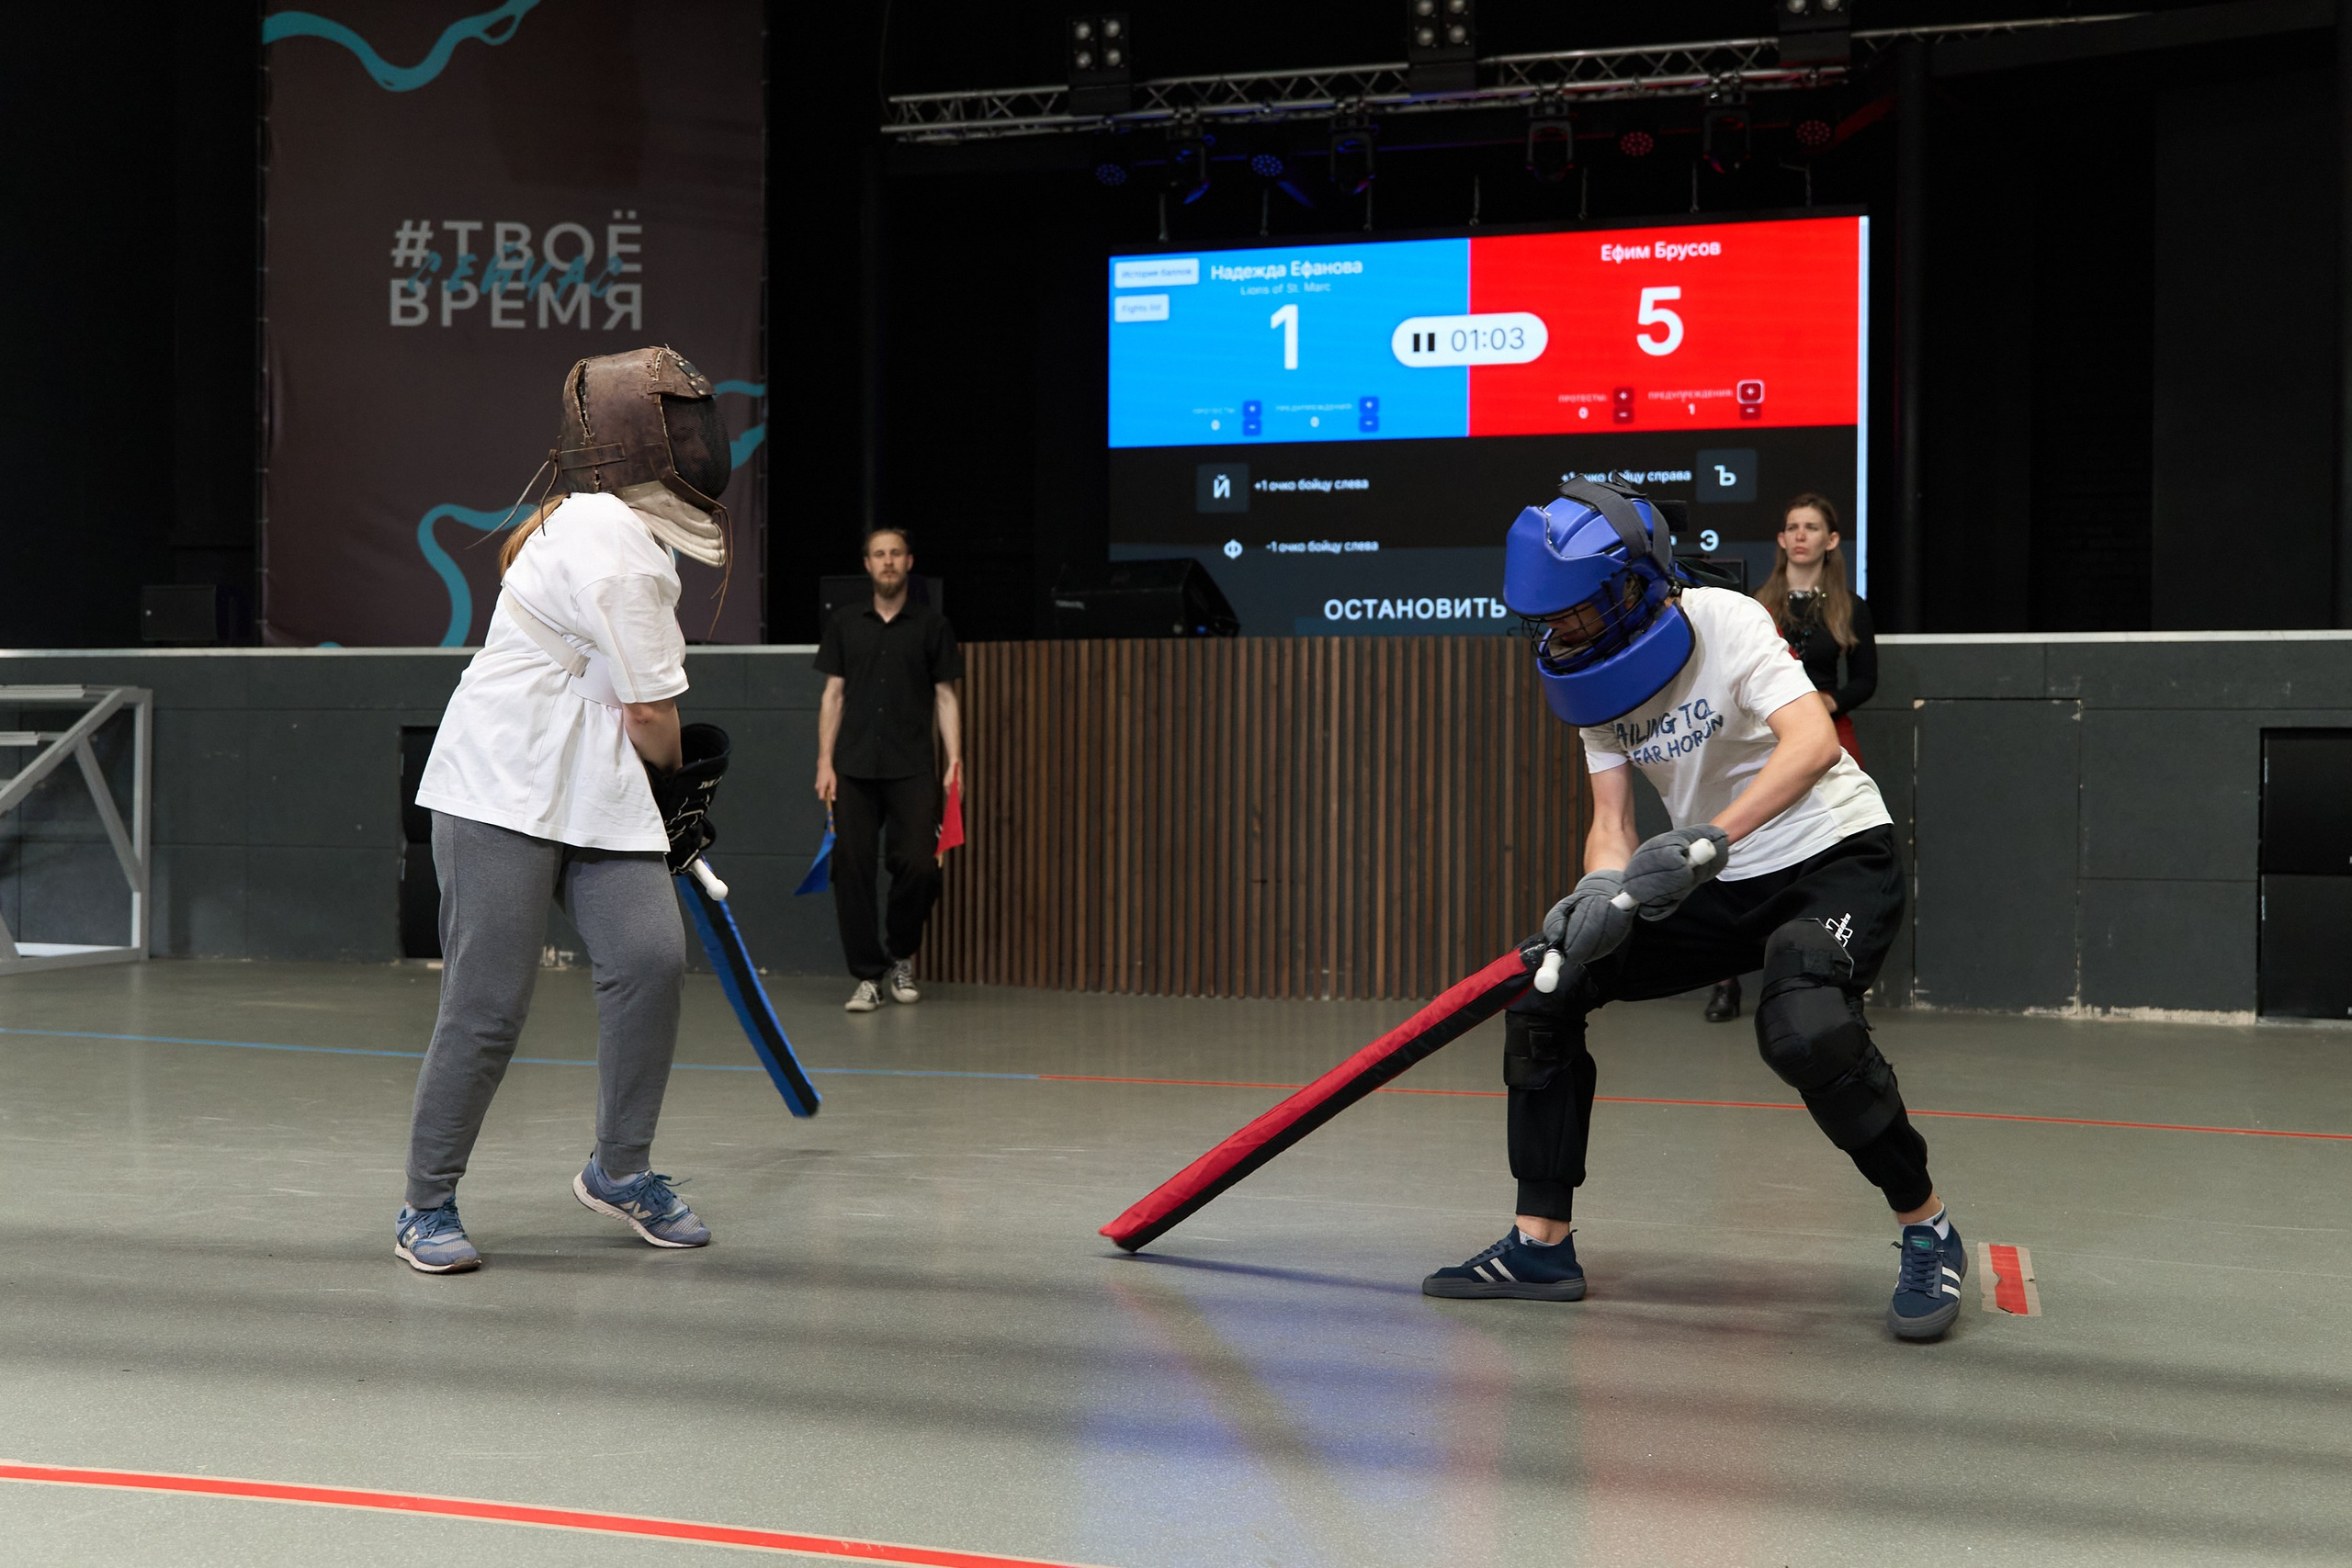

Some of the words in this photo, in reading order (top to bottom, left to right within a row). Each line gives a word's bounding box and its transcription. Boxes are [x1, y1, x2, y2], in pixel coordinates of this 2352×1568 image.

[390, 209, 642, 273] #ТВОЁ
[1600, 243, 1651, 264] Ефим
[1655, 241, 1722, 261] Брусов
[1211, 264, 1286, 281] Надежда
[1290, 260, 1363, 279] Ефанова
[390, 278, 642, 331] ВРЕМЯ
[1636, 286, 1684, 356] 5
[1270, 303, 1298, 370] 1
[1451, 326, 1525, 353] 01:03
[1213, 473, 1231, 499] Й
[1269, 480, 1296, 491] очко
[1297, 478, 1332, 492] бойцу
[1334, 479, 1370, 490] слева
[1583, 472, 1606, 483] чко
[1647, 469, 1692, 483] справа
[1713, 464, 1736, 487] Ъ
[1224, 538, 1243, 559] Ф
[1278, 541, 1306, 553] очко
[1307, 539, 1343, 555] бойцу
[1344, 540, 1379, 552] слева
[1700, 529, 1720, 551] Э
[1324, 597, 1509, 620] ОСТАНОВИТЬ
[1615, 712, 1678, 749] AILING
[1633, 745, 1669, 767] FAR
